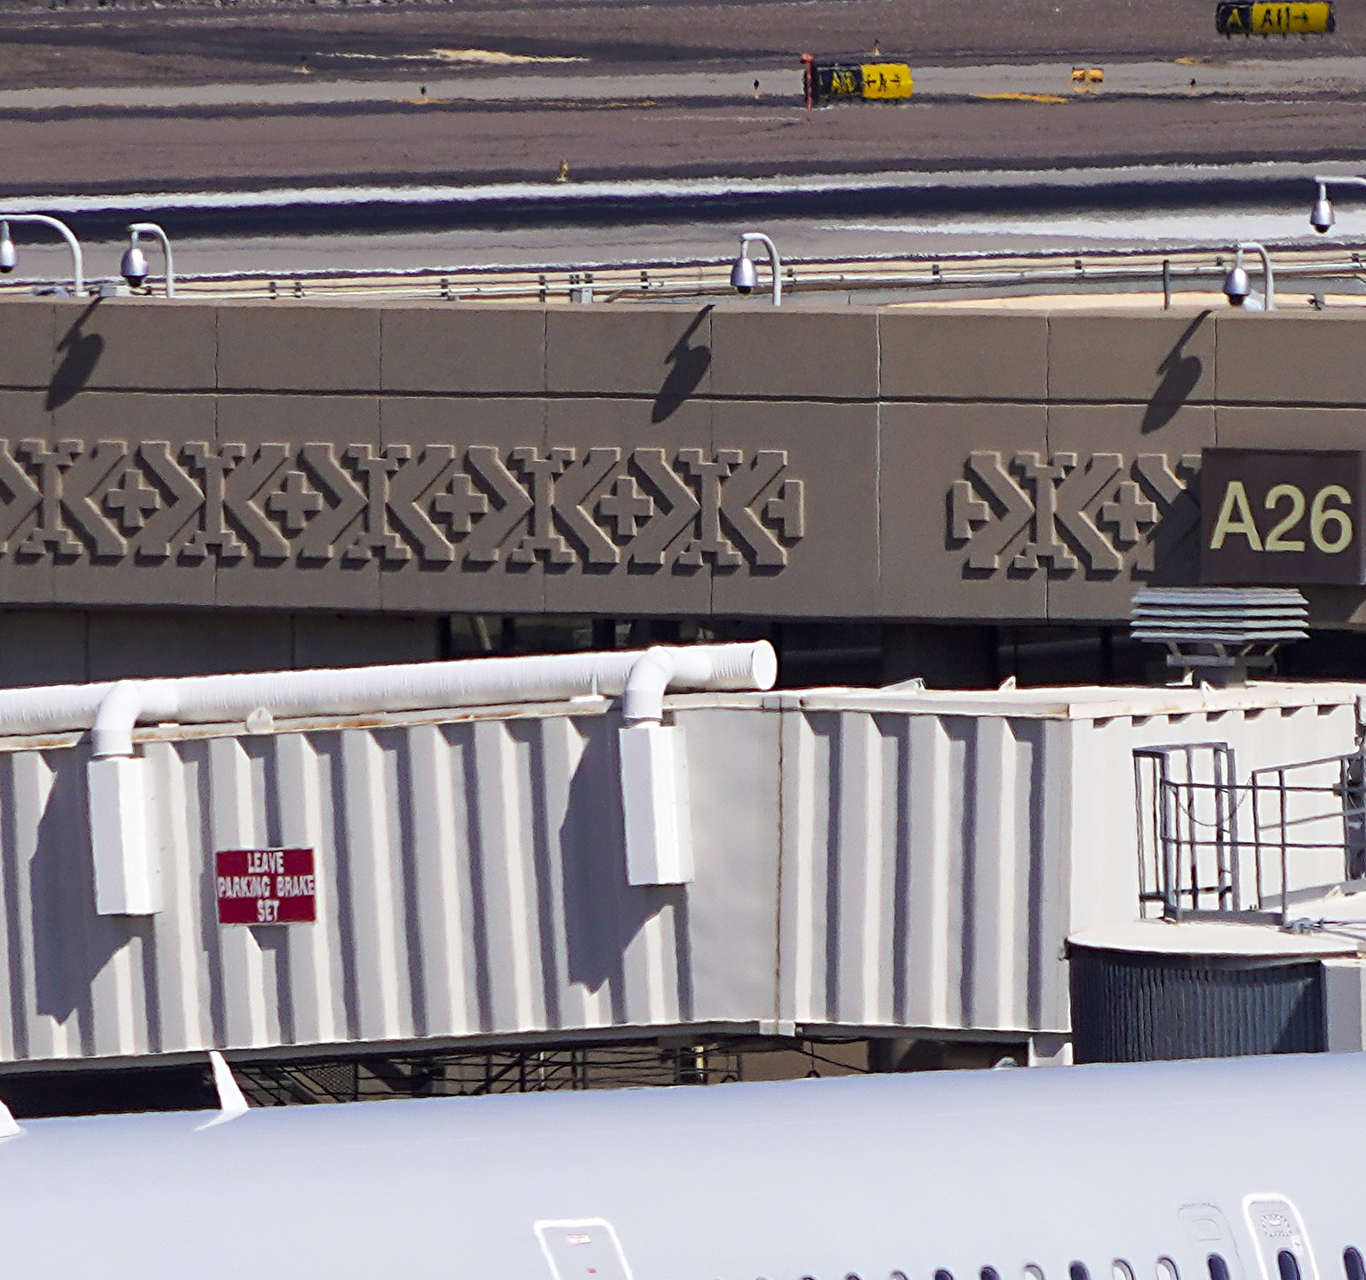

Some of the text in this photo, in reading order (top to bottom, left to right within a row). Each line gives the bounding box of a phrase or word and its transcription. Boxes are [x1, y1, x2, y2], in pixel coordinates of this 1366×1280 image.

[1226, 6, 1291, 31] A A11
[1209, 480, 1353, 554] A26
[246, 851, 284, 874] LEAVE
[216, 874, 315, 898] PARKING BRAKE
[256, 899, 281, 922] SET
